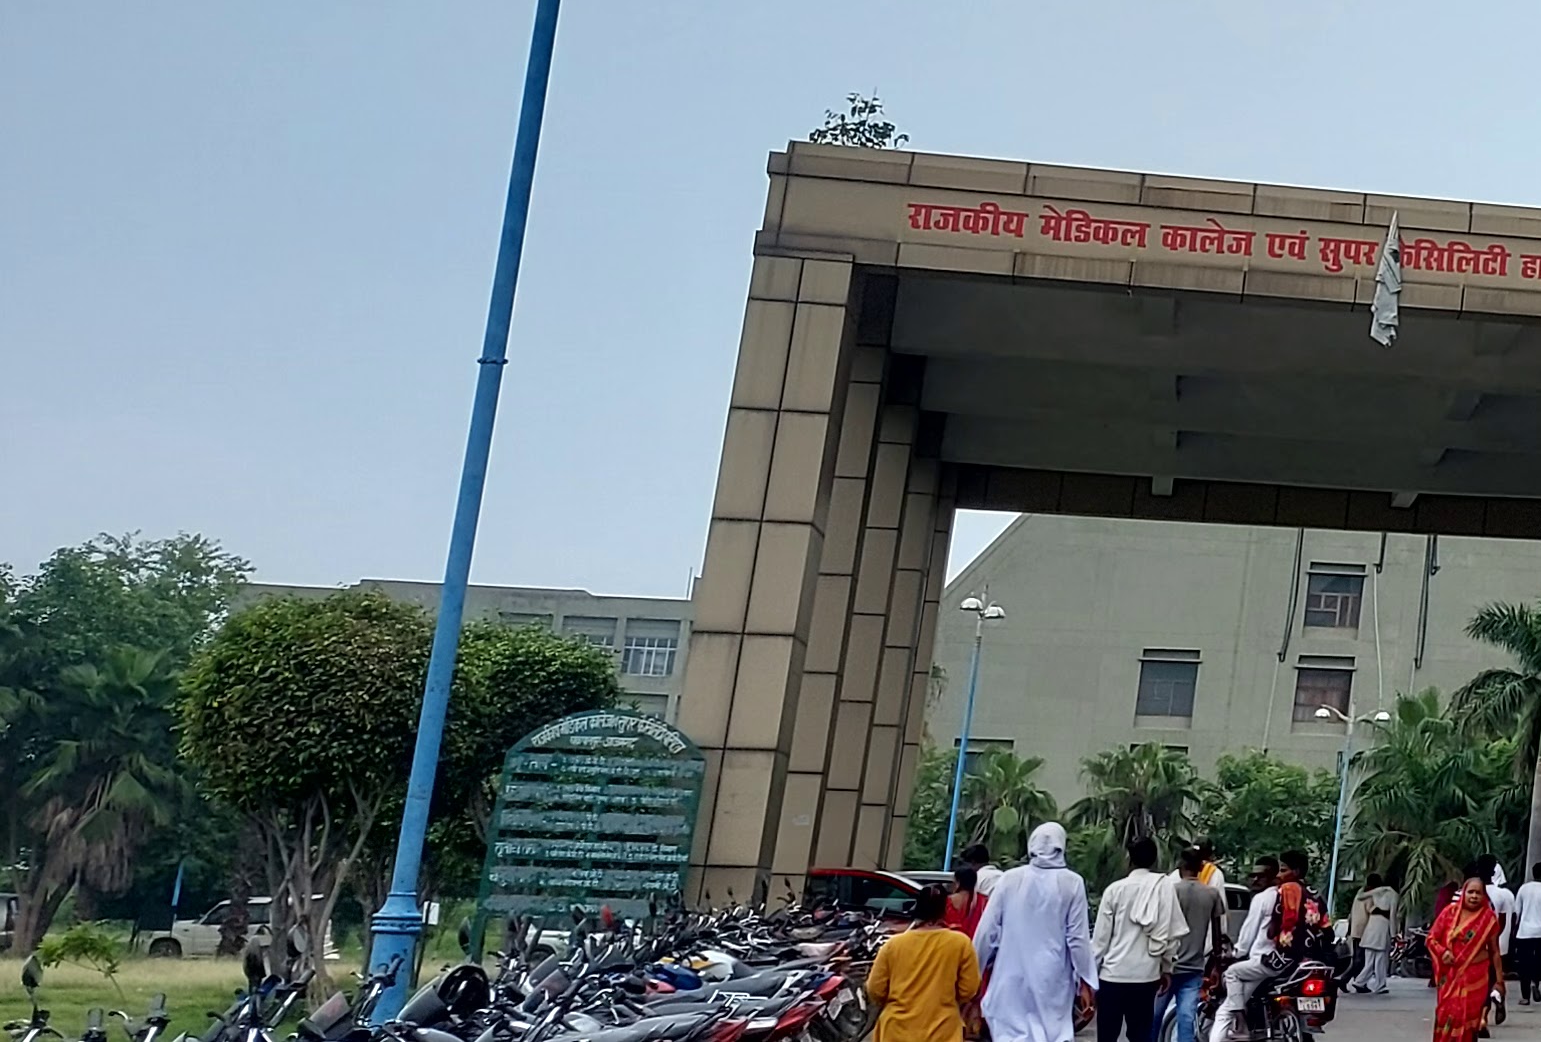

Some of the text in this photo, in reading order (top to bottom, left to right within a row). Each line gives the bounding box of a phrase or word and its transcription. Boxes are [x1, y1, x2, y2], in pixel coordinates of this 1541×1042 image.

[908, 202, 1029, 238] राजकीय
[1039, 204, 1151, 248] मेडिकल
[1160, 218, 1256, 257] कालेज
[1265, 229, 1308, 261] एवं
[1318, 237, 1380, 273] सुपर
